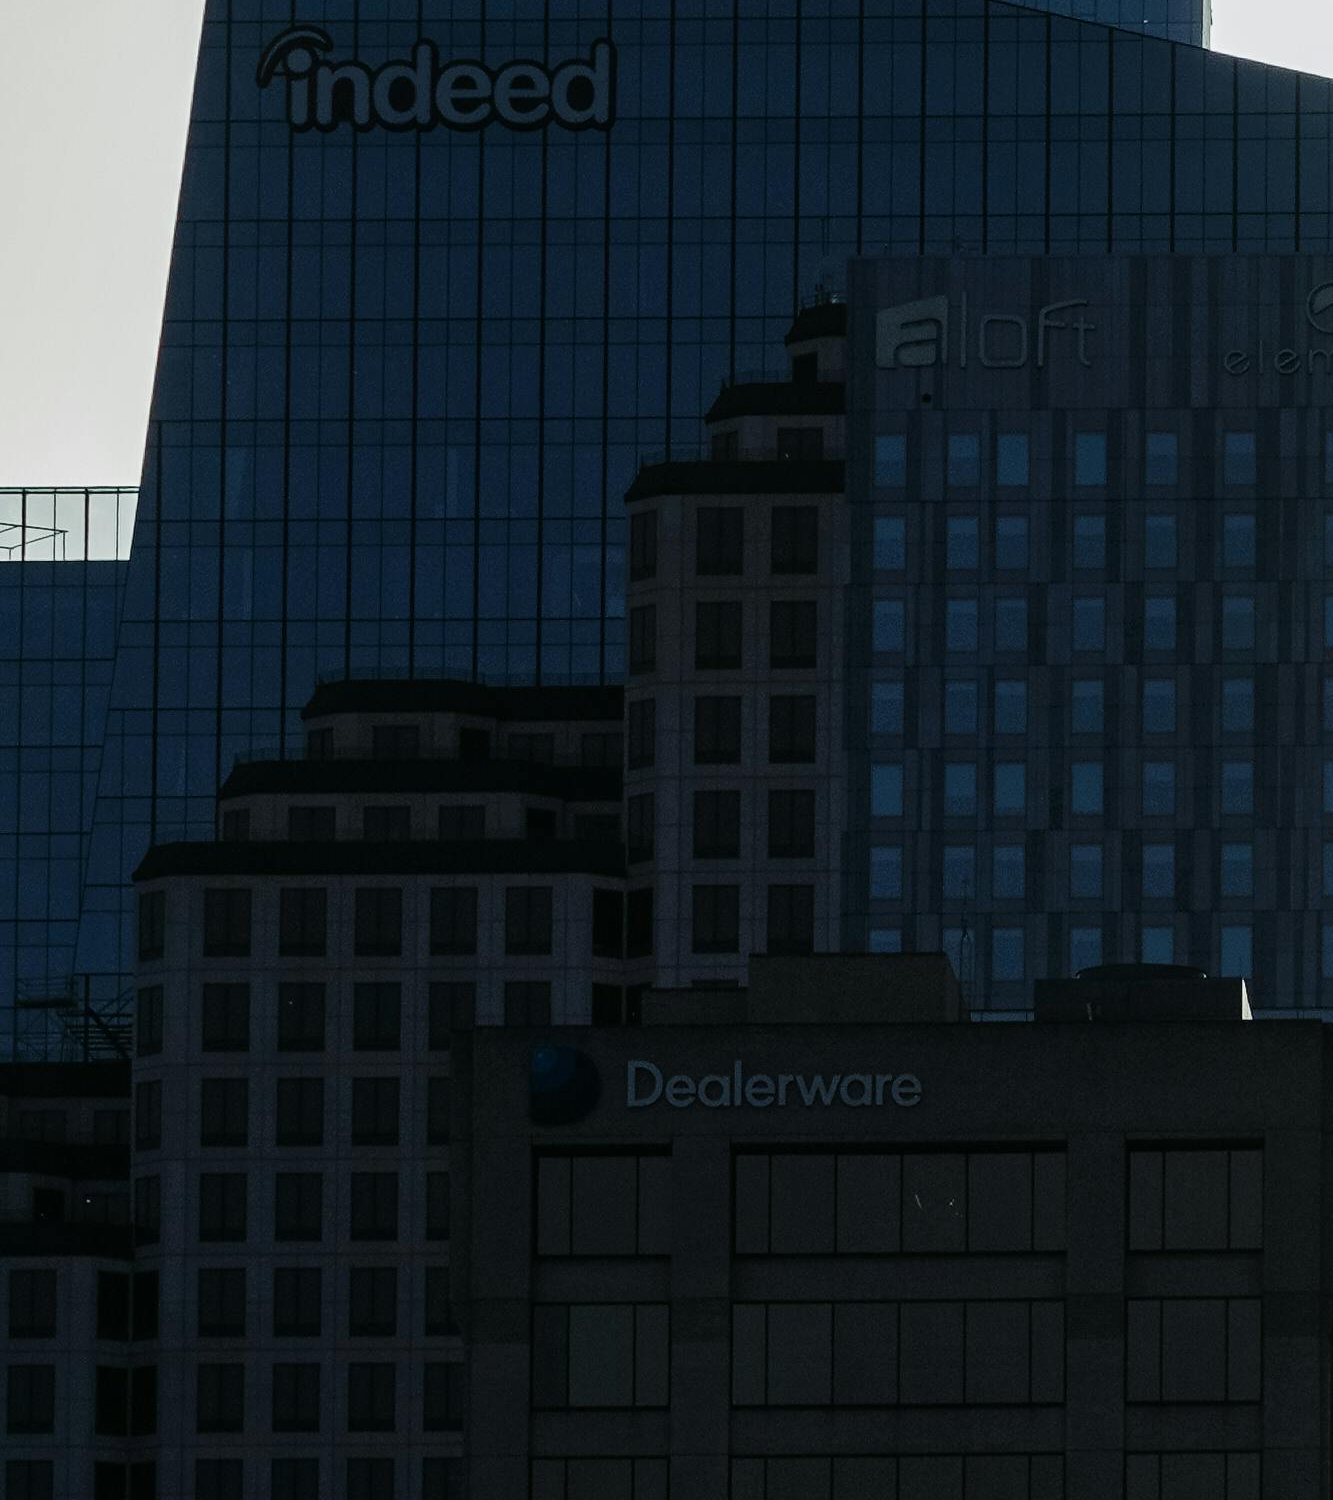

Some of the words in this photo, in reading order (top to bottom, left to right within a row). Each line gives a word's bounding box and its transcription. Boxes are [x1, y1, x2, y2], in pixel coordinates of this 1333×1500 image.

[264, 27, 616, 132] indeed
[875, 292, 1096, 368] aloft
[626, 1059, 923, 1107] Dealerware
